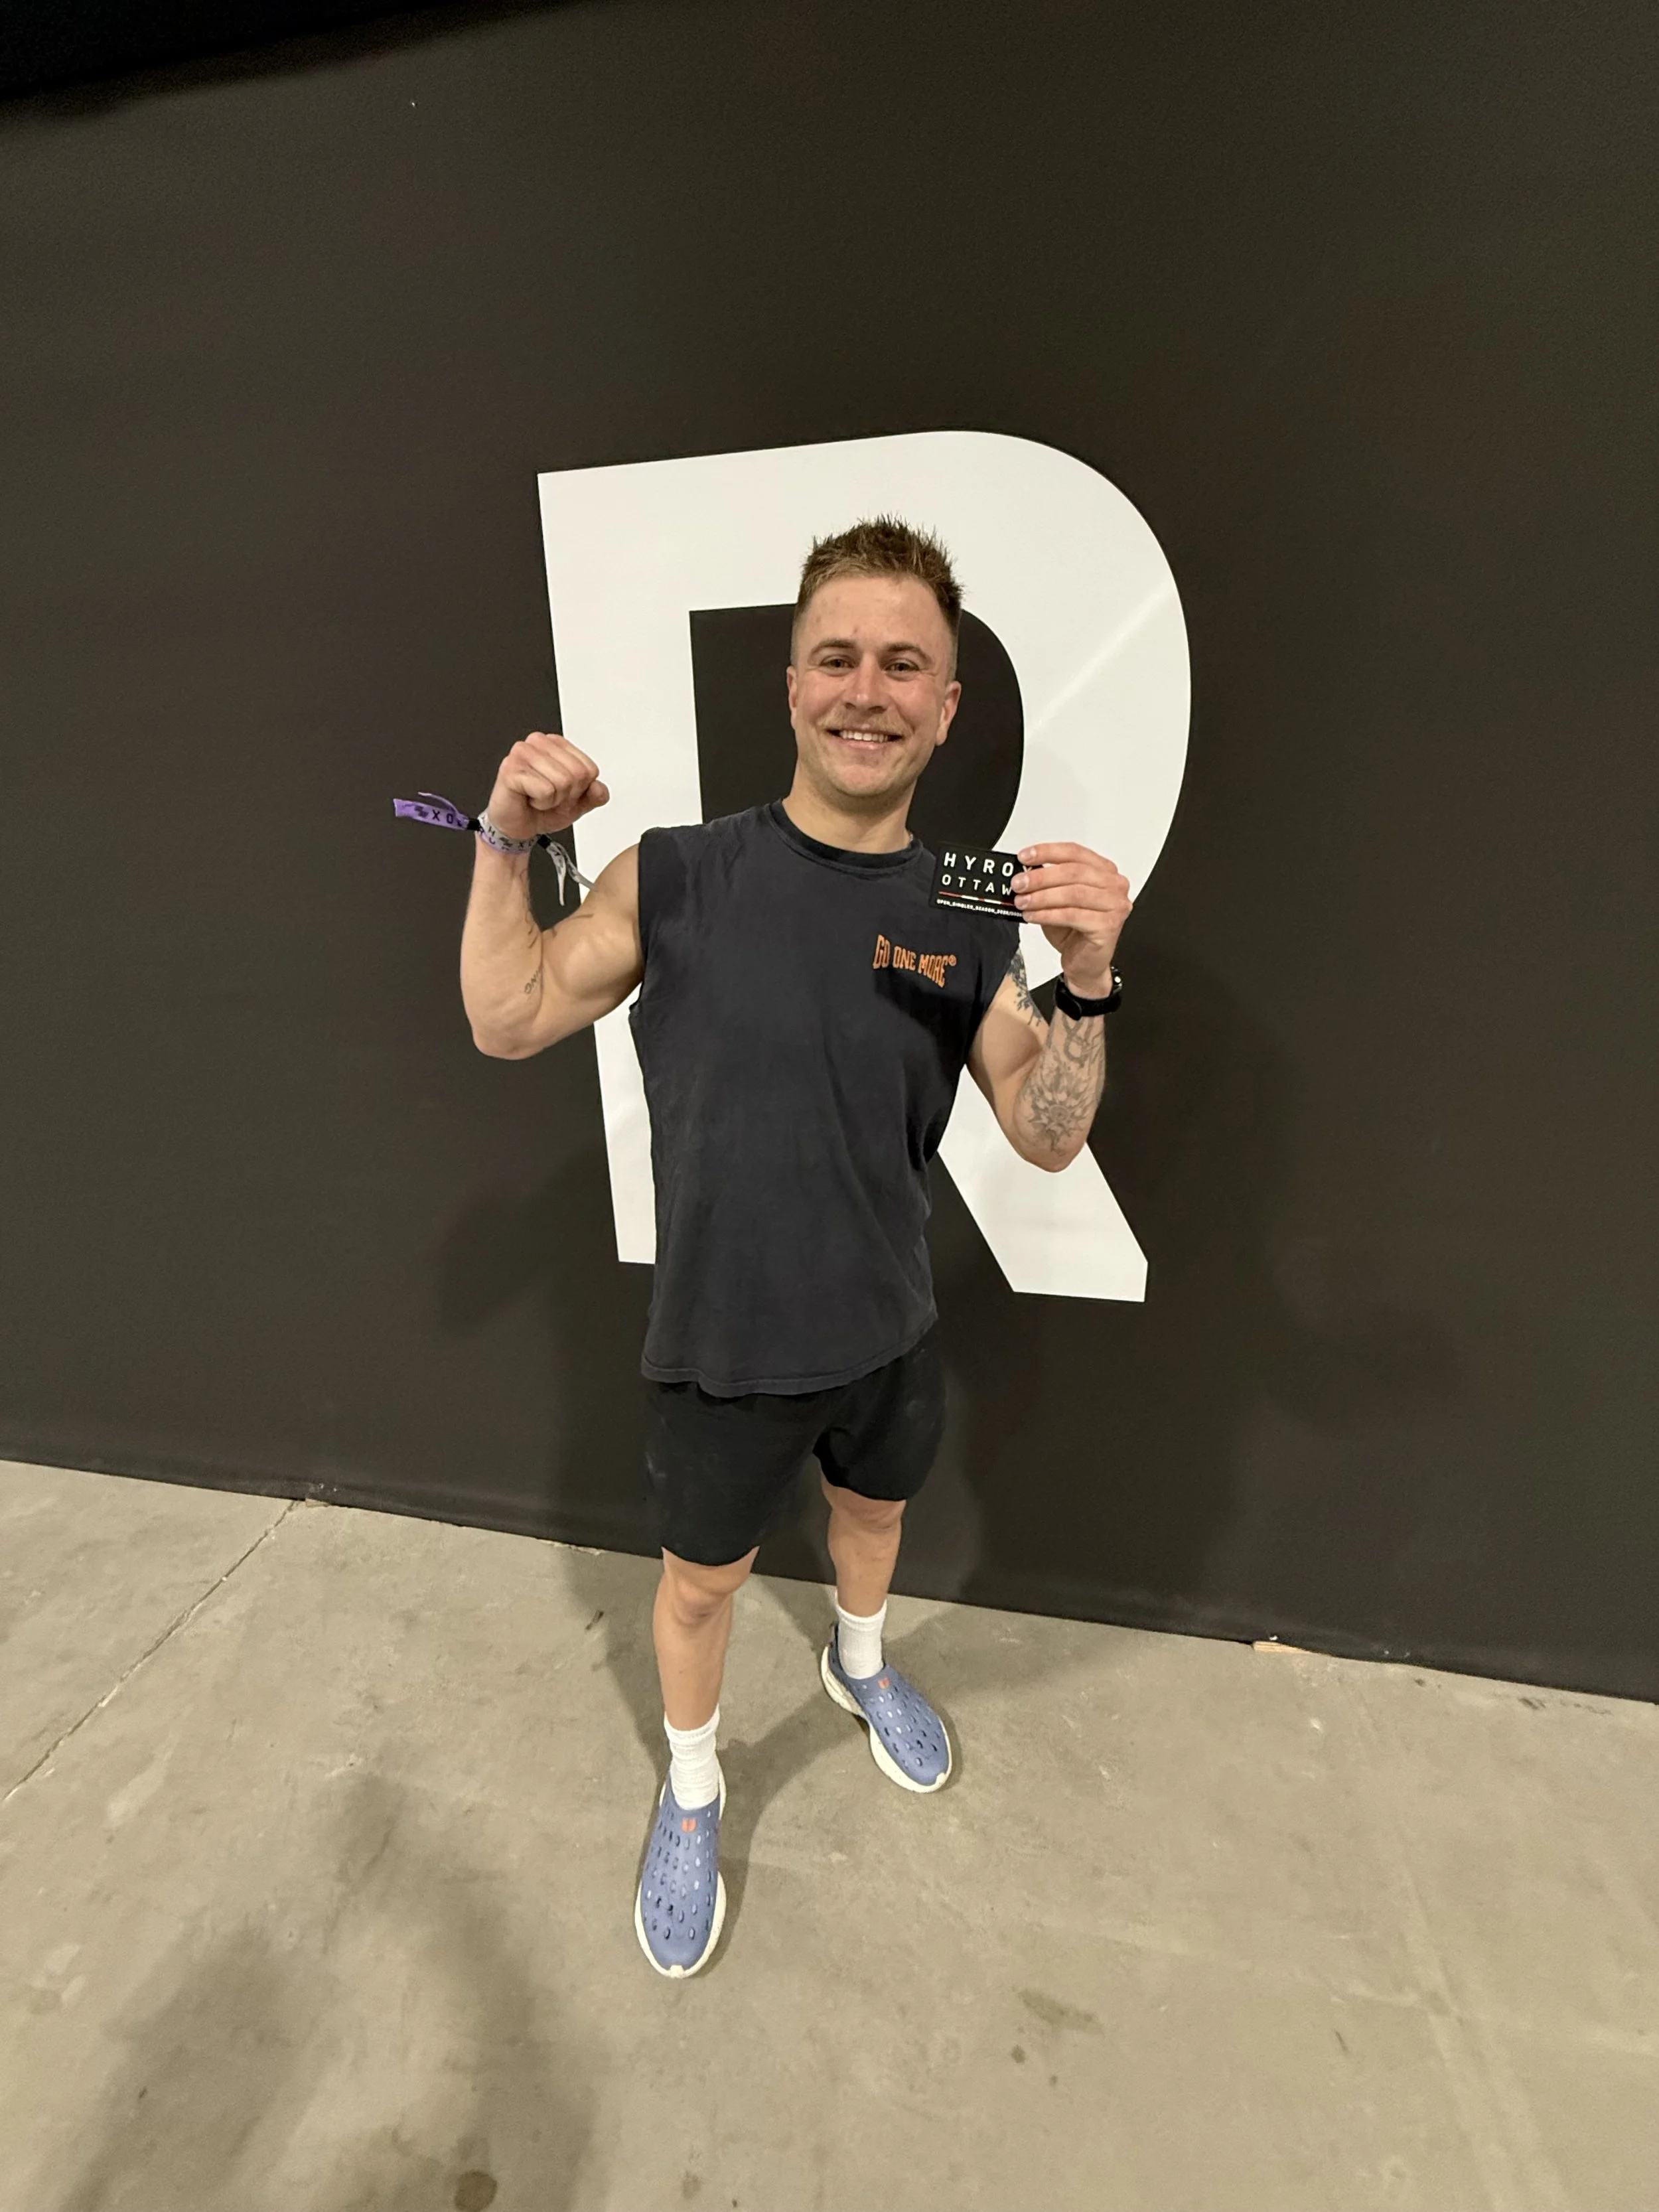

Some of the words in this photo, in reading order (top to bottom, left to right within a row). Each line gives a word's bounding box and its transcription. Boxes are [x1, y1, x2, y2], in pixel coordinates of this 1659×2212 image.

[537, 430, 1192, 1303] R
[941, 874, 1013, 896] OTTAW
[873, 934, 891, 970] GO
[893, 945, 916, 971] ONE
